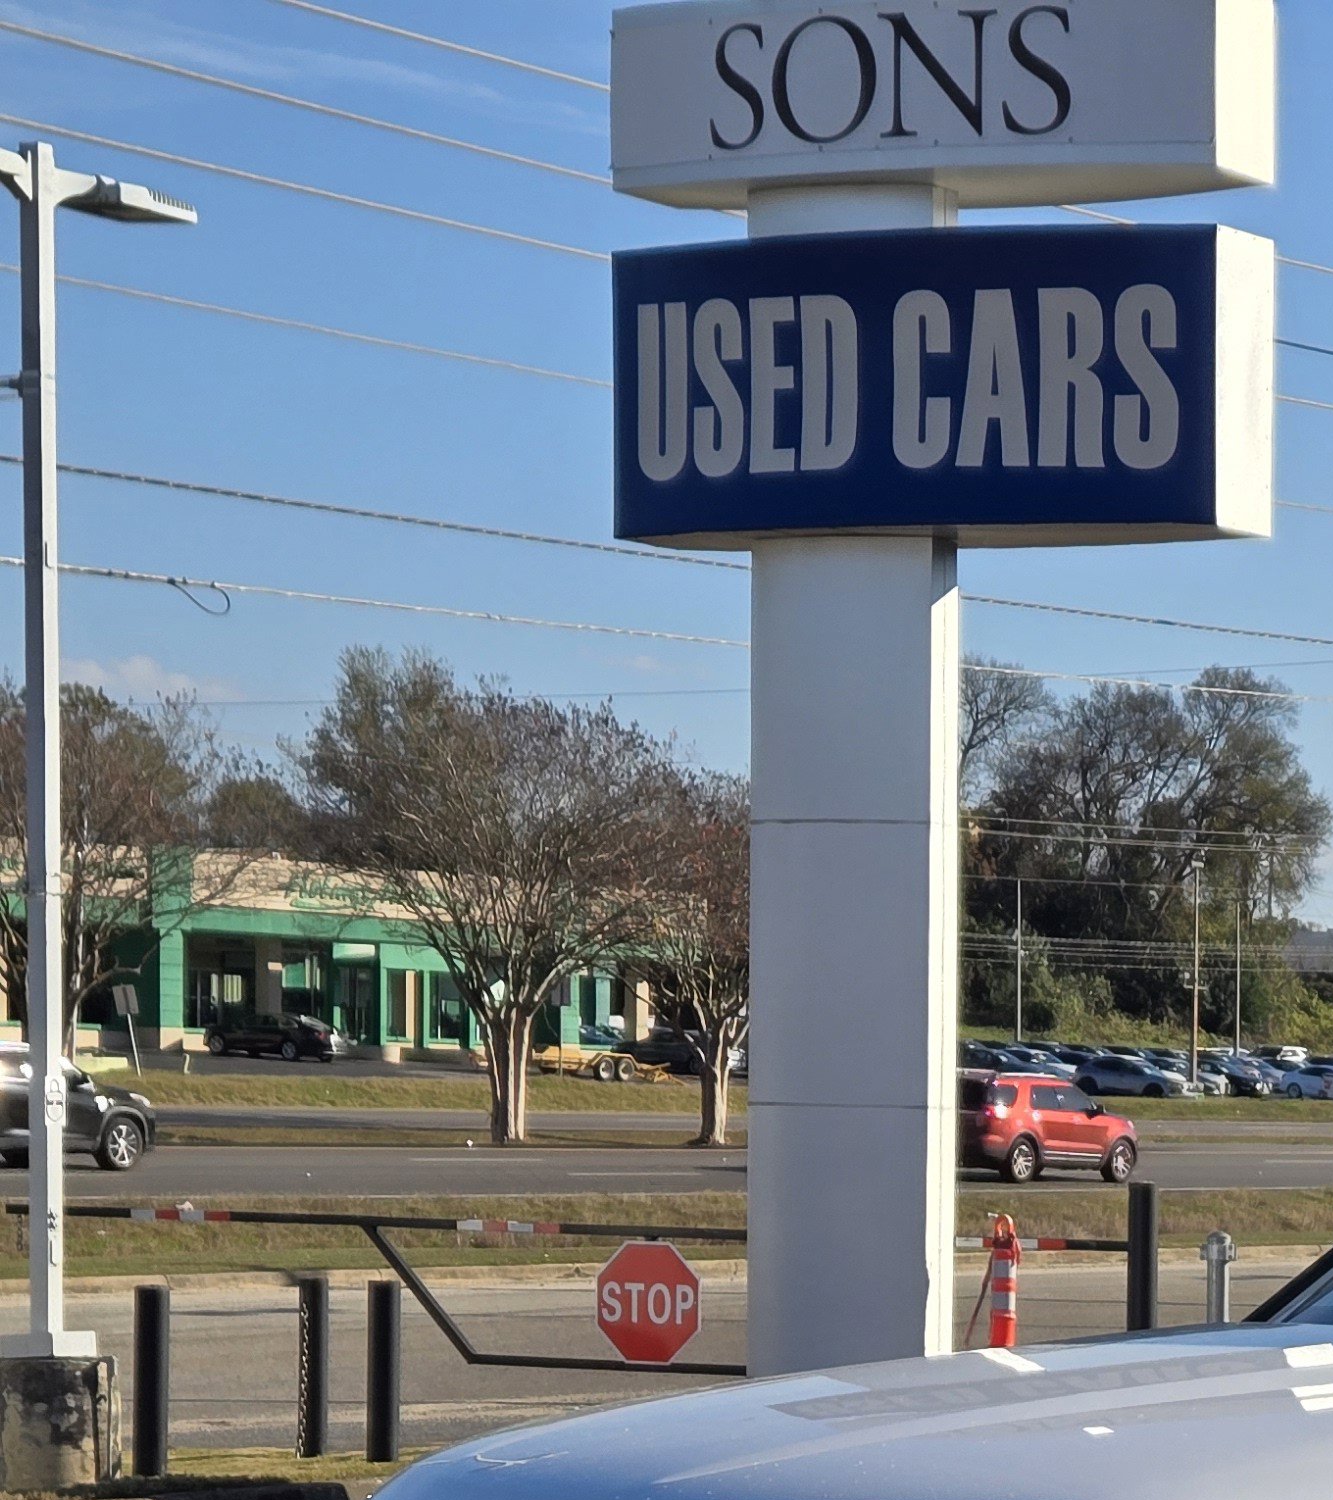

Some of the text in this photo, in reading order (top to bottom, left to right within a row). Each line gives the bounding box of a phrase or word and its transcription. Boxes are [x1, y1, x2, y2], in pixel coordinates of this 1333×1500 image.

[709, 5, 1072, 151] SONS
[637, 283, 1179, 482] USED CARS
[601, 1280, 695, 1326] STOP
